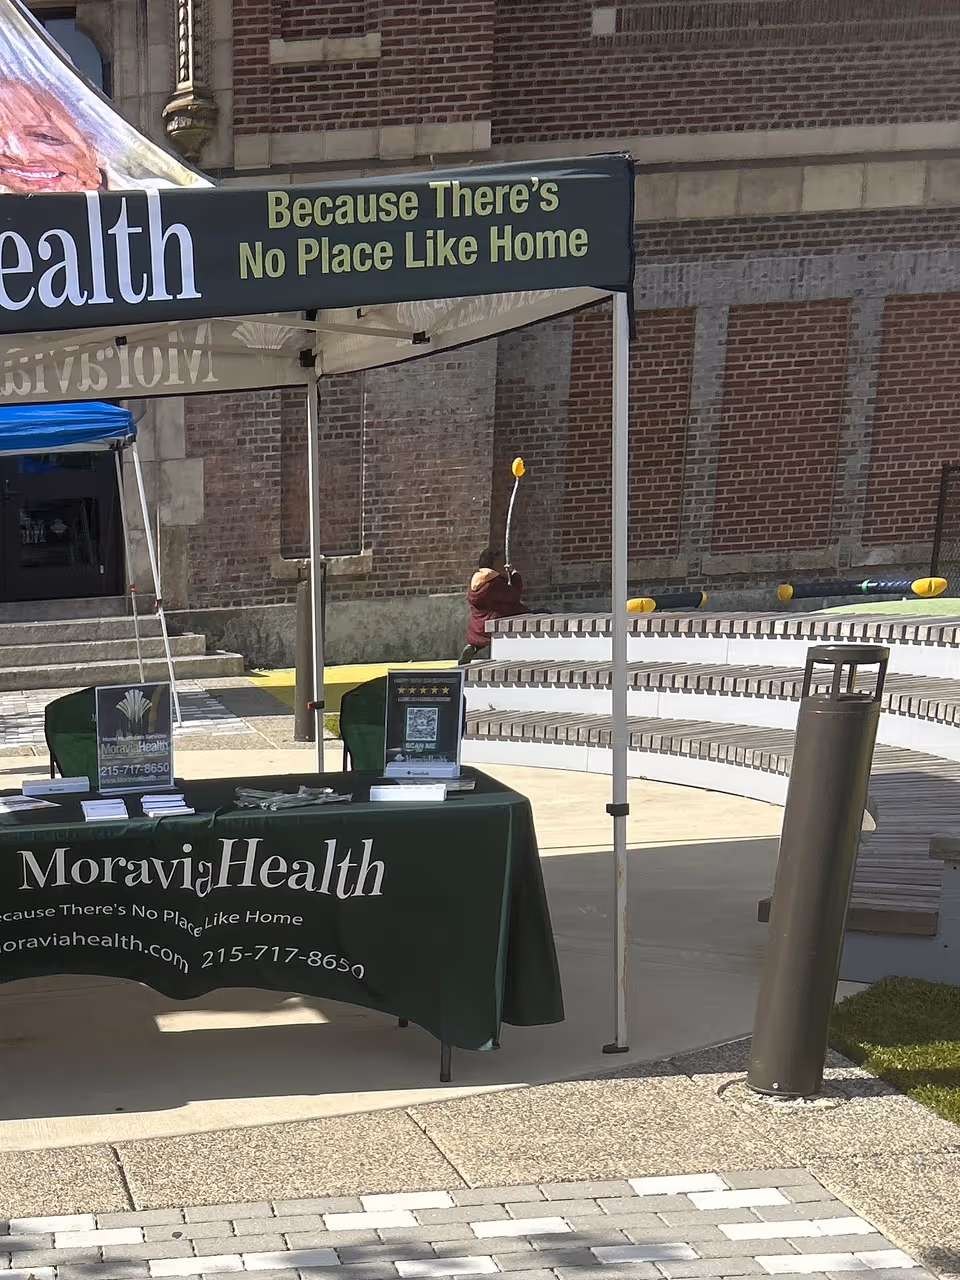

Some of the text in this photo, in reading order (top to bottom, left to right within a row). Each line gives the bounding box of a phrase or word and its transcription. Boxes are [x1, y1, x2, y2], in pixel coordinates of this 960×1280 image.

[268, 176, 560, 230] Because There’s
[240, 225, 589, 280] No Place Like Home
[101, 741, 169, 755] MoraviaHealth
[101, 762, 170, 776] 215-717-8650
[17, 838, 386, 900] MoraviaHealth
[59, 903, 127, 918] There's
[132, 904, 159, 919] No
[163, 909, 203, 938] Place
[204, 910, 240, 931] Like
[245, 910, 304, 927] Home
[200, 944, 366, 980] 215-717-8650
